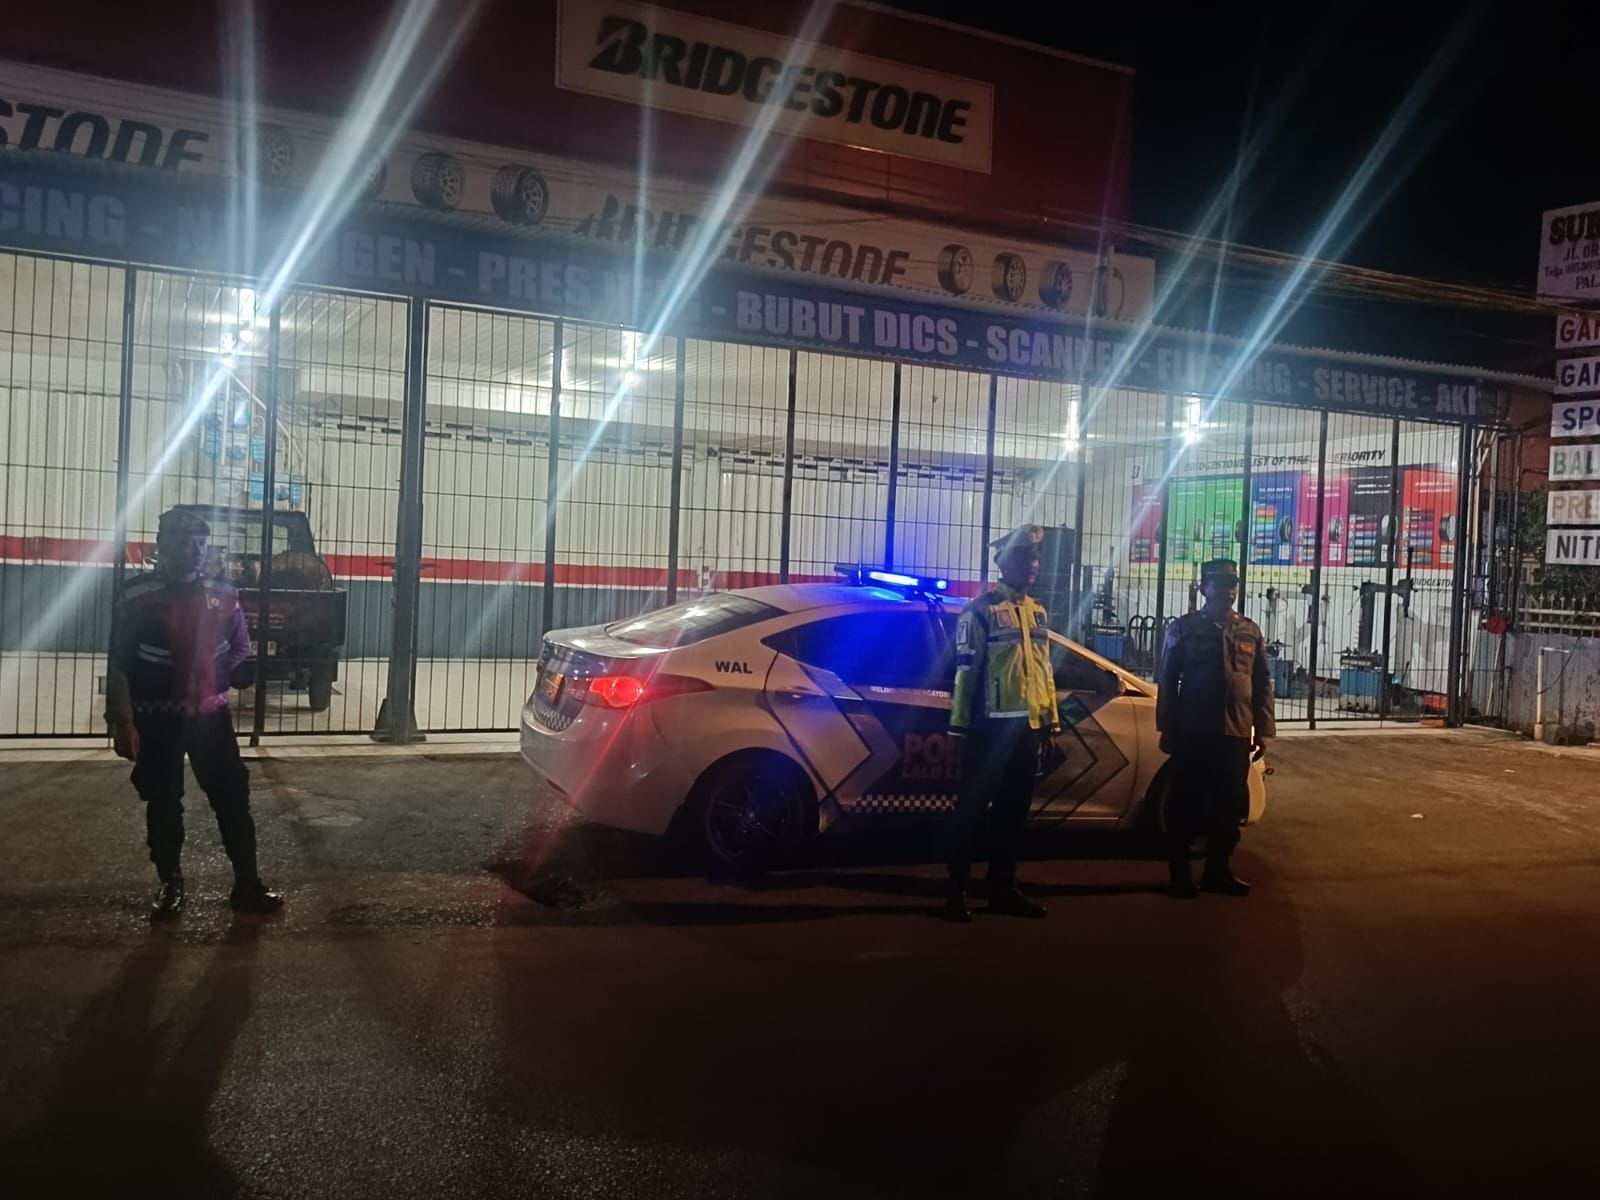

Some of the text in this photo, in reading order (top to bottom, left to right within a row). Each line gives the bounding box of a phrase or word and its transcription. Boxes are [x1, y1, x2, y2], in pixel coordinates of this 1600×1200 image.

[588, 15, 971, 144] BRIDGESTONE
[477, 250, 591, 307] PRES
[736, 290, 865, 344] BUBUT
[874, 309, 959, 356] DICS
[986, 325, 1132, 376] SCANNER
[1158, 349, 1291, 394] FLUING
[1313, 367, 1419, 409] SERVICE
[1435, 383, 1477, 416] AKI
[715, 660, 752, 674] WAL
